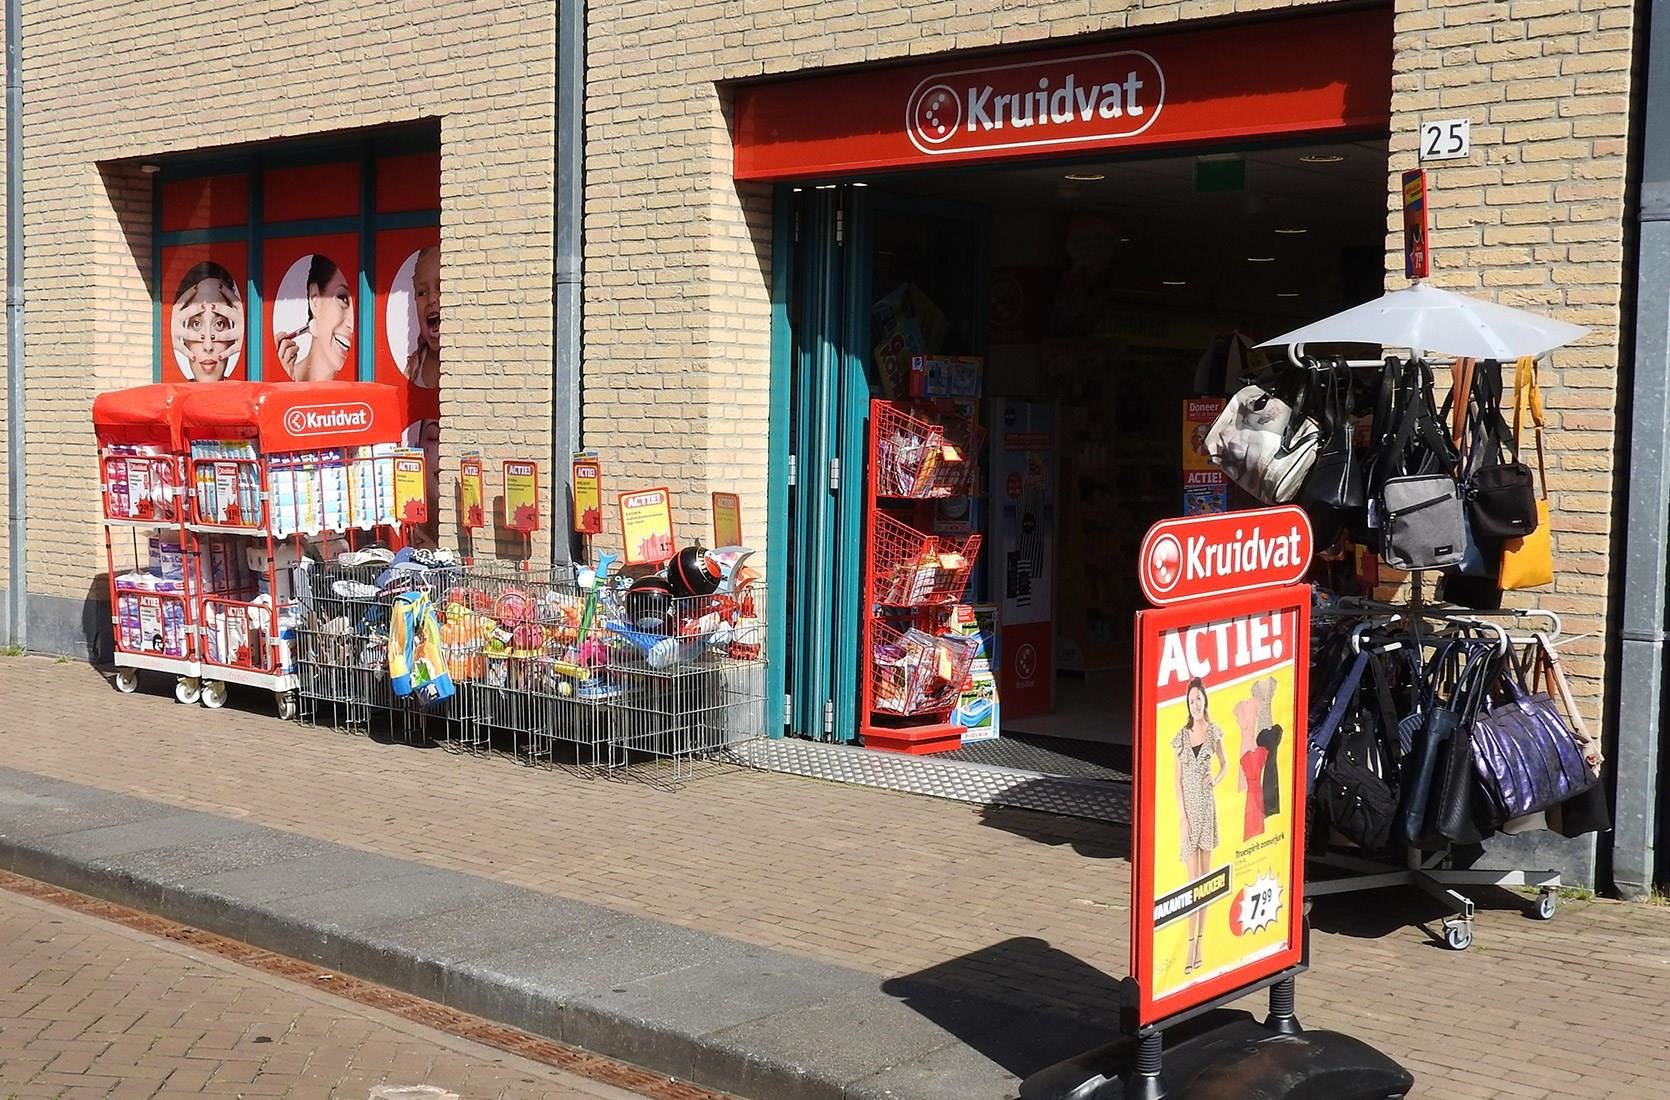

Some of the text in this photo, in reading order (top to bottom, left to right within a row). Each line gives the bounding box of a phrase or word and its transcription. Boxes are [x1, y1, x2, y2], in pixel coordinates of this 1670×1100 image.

[967, 71, 1144, 132] Kruidvat
[1426, 123, 1464, 155] 25
[306, 409, 367, 429] Kruidvat
[1189, 402, 1219, 412] Doneer
[1187, 472, 1223, 484] ACTIE!
[627, 493, 661, 508] ACTIE!
[1186, 525, 1302, 581] Kruidvat
[1157, 609, 1283, 687] ACTIE!
[1250, 888, 1273, 920] 7.99
